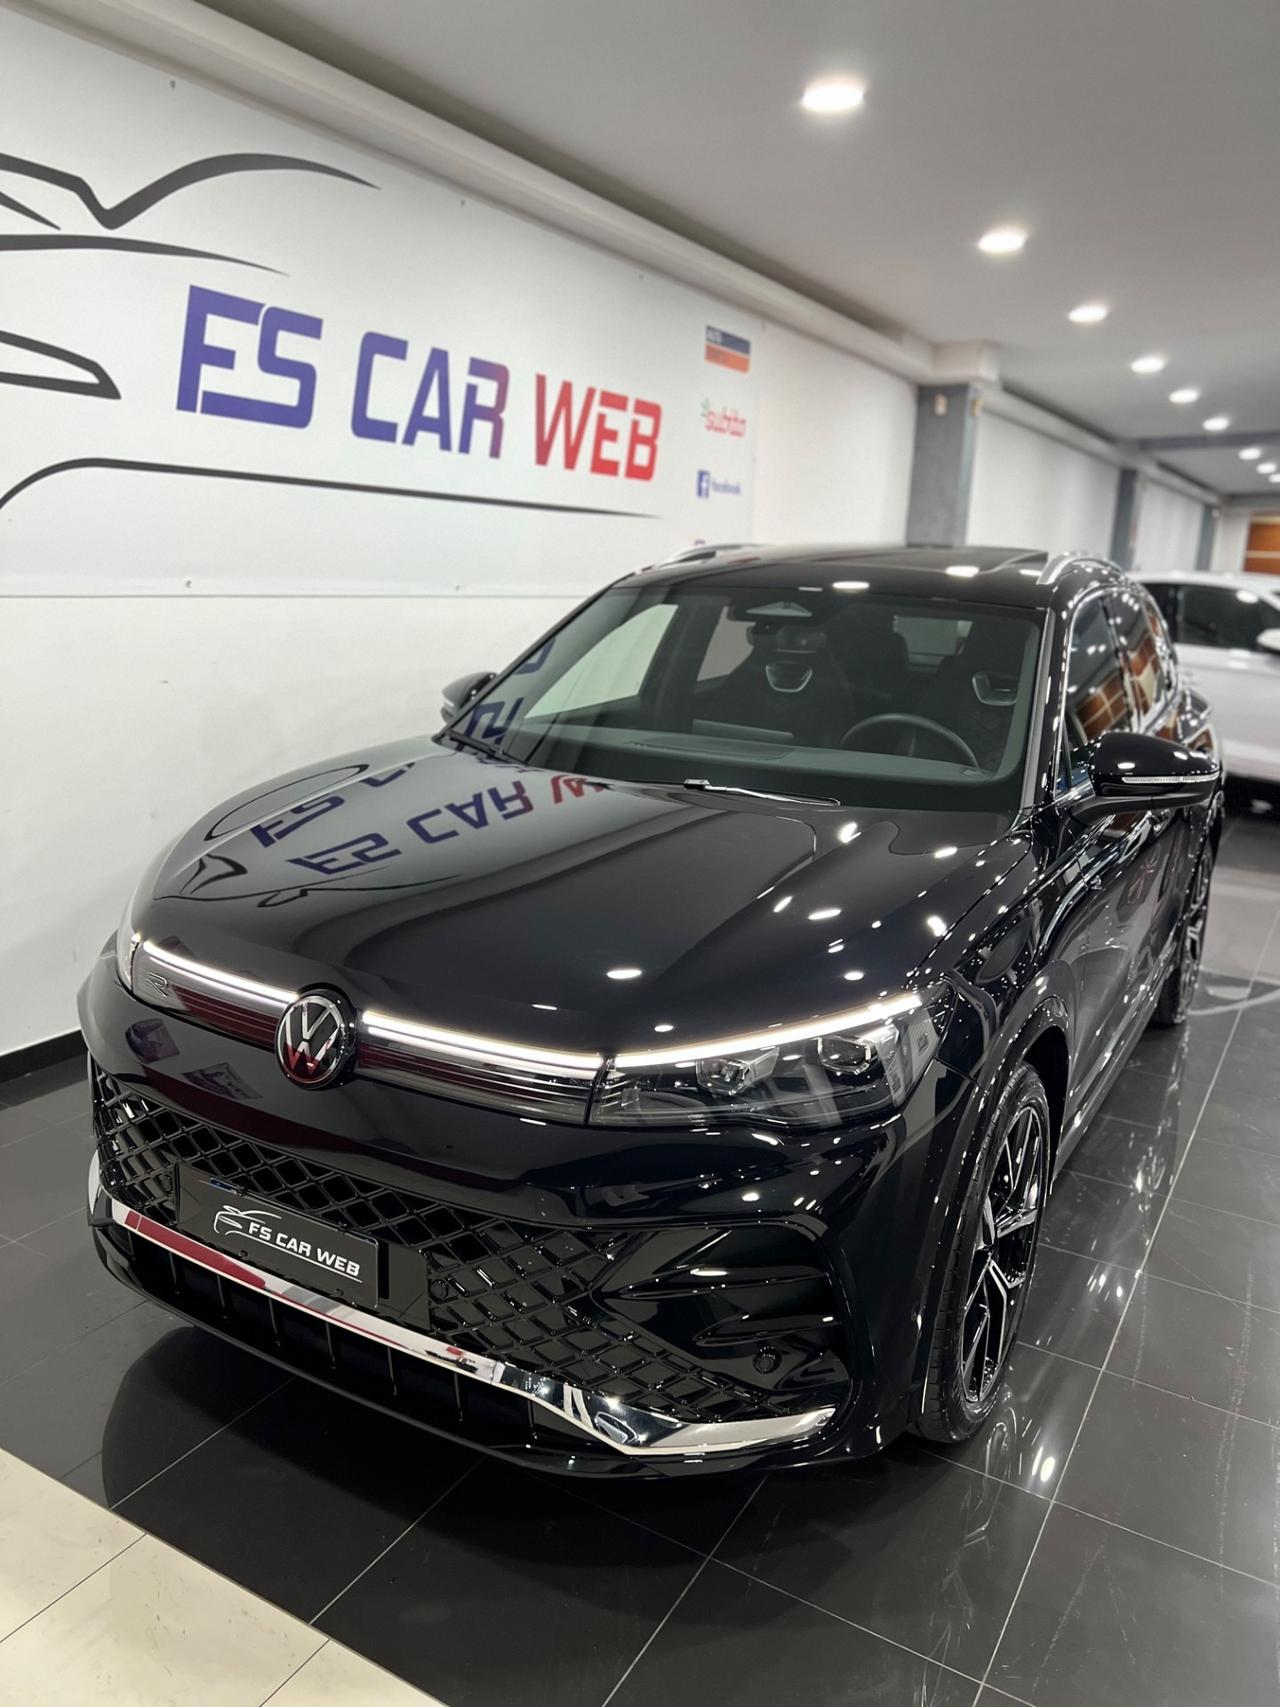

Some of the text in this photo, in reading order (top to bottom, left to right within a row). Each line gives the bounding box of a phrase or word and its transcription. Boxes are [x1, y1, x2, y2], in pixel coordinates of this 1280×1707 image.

[350, 331, 510, 459] CAR
[534, 373, 663, 482] WEB
[275, 1232, 312, 1257] CAR
[316, 1247, 361, 1277] WEB
